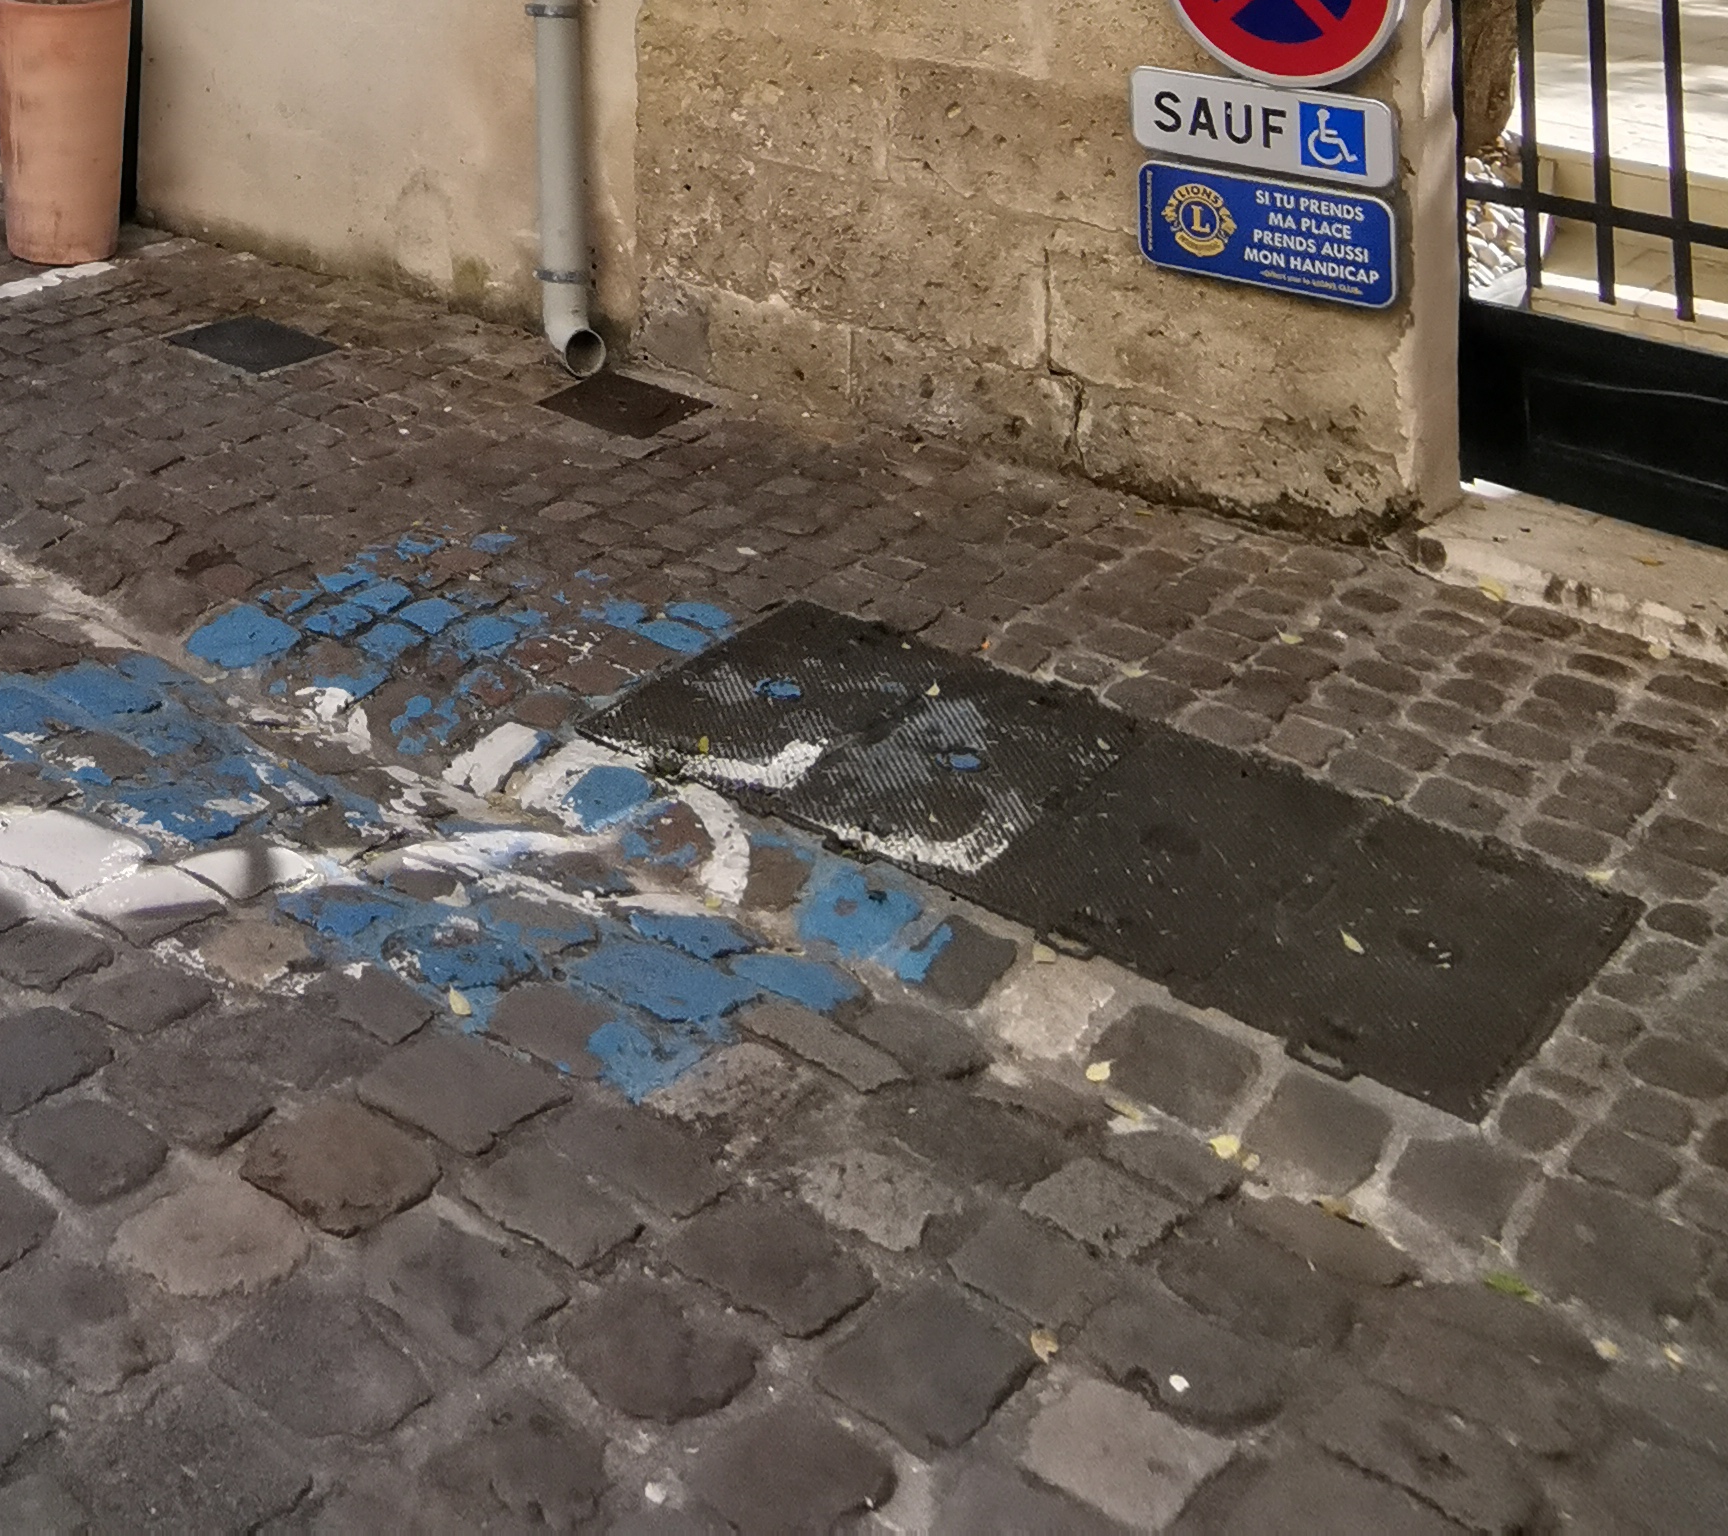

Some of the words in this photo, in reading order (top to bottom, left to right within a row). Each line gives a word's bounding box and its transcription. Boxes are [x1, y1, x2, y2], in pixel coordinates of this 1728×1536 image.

[1153, 90, 1288, 149] SAUF
[1176, 183, 1222, 206] LIONS
[1255, 189, 1270, 206] SI
[1273, 192, 1295, 210] TU
[1299, 199, 1365, 222] PRENDS
[1191, 205, 1211, 233] L
[1268, 212, 1297, 231] MA
[1301, 218, 1352, 240] PLACE
[1253, 229, 1317, 254] PRENDS
[1321, 242, 1369, 264] AUSSI
[1243, 247, 1286, 268] MON
[1289, 257, 1380, 285] HANDICAP
